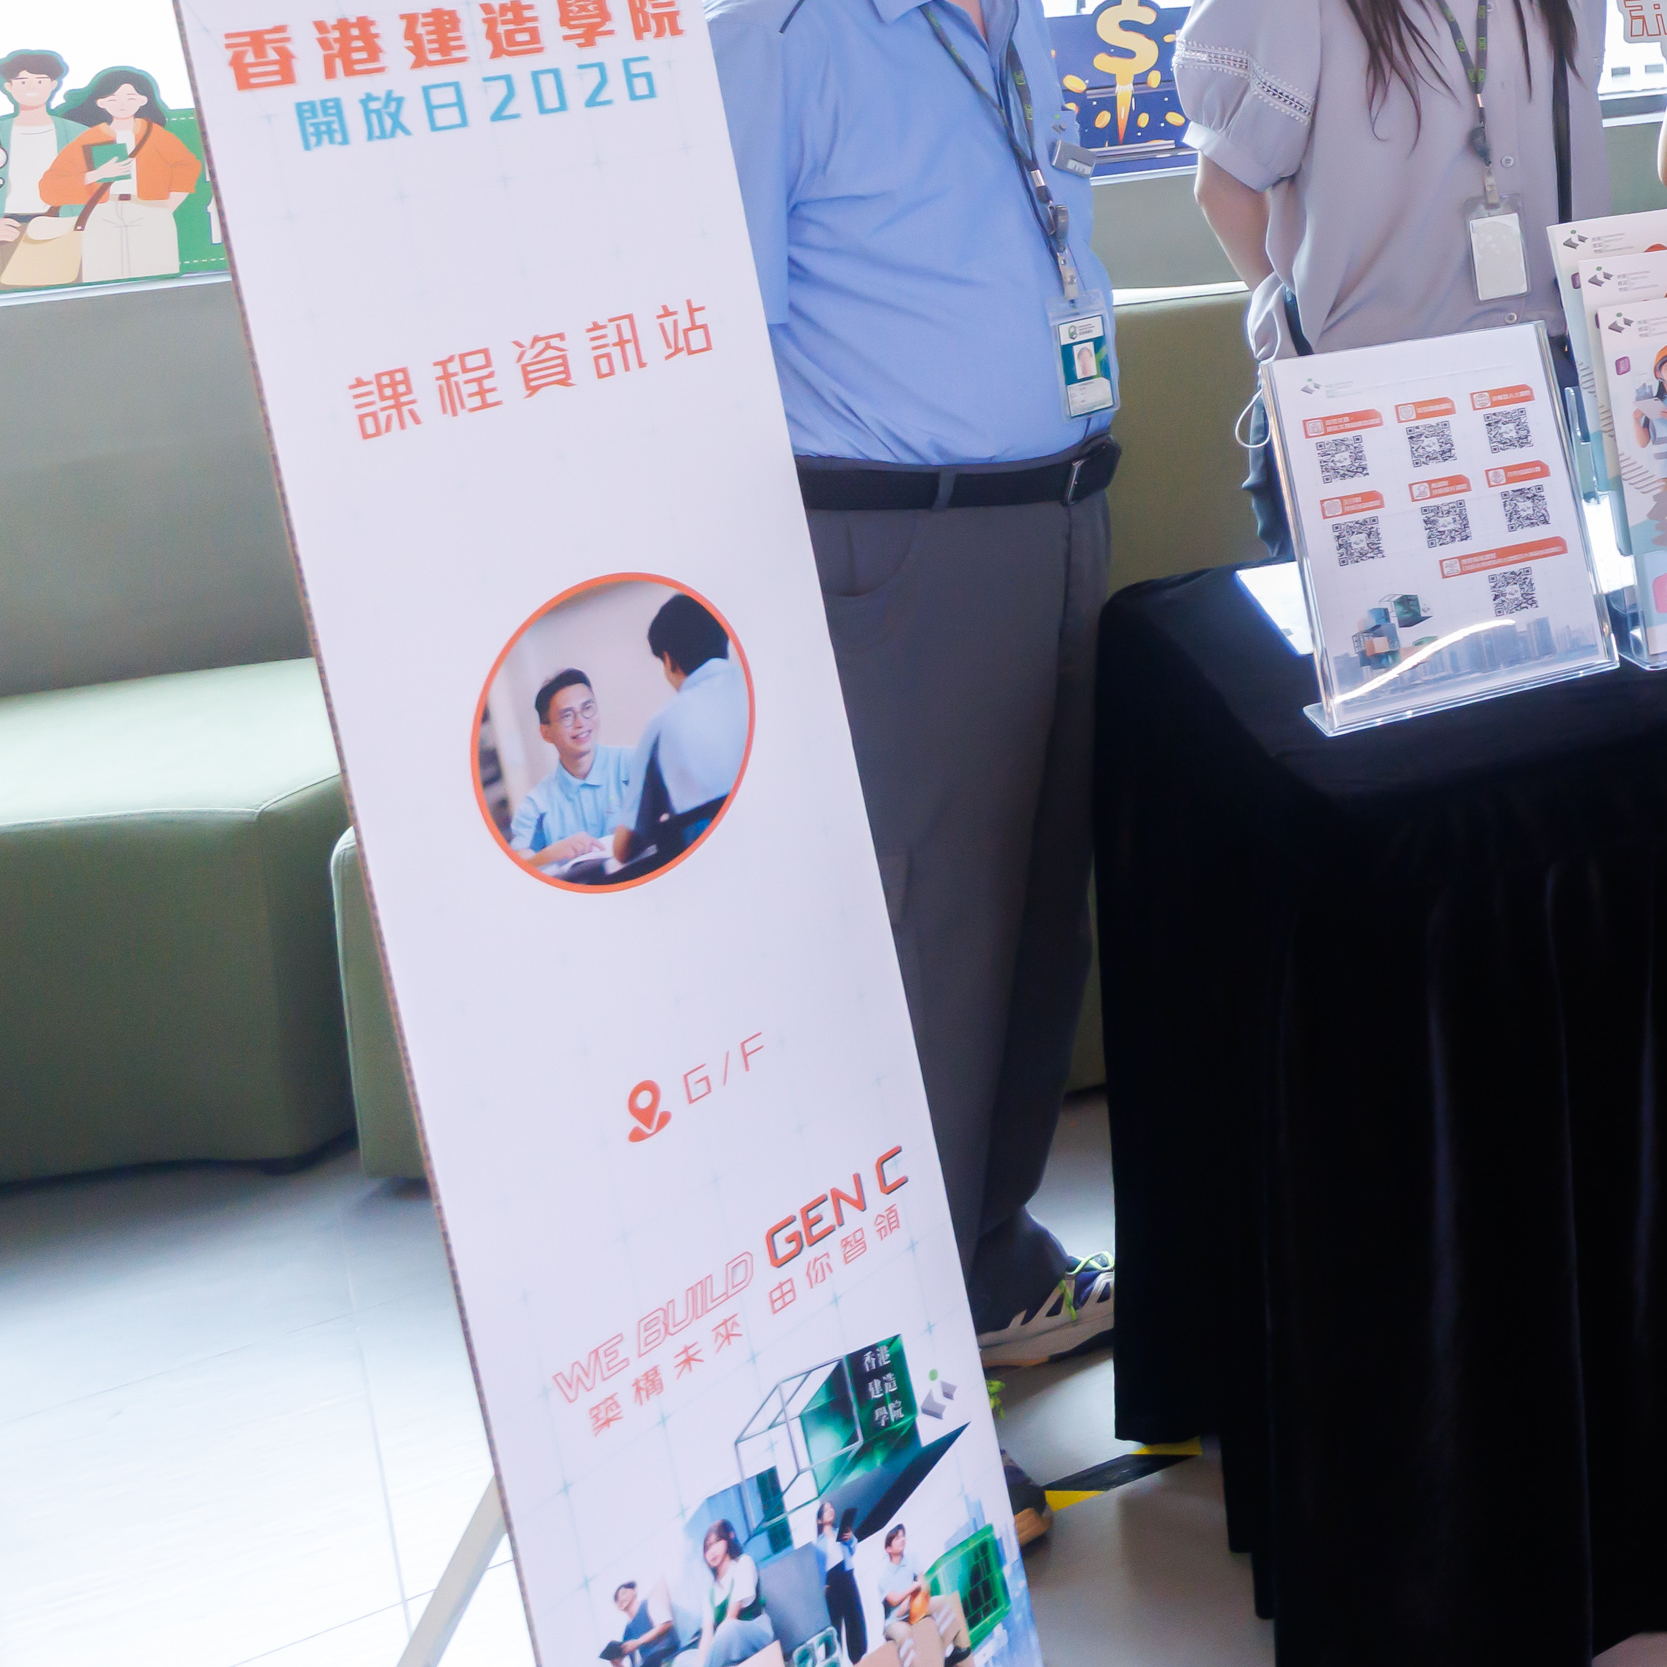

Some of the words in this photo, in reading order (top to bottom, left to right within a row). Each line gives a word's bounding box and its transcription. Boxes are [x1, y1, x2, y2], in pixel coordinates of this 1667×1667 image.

[295, 55, 658, 152] 開放日2026
[348, 298, 714, 440] 課程資訊站
[683, 1032, 765, 1104] G/F
[553, 1333, 630, 1403] WE
[637, 1251, 754, 1357] BUILD
[765, 1173, 865, 1268] GEN
[877, 1146, 909, 1195] C
[589, 1317, 742, 1436] 築構未來
[768, 1203, 901, 1315] 由你智領
